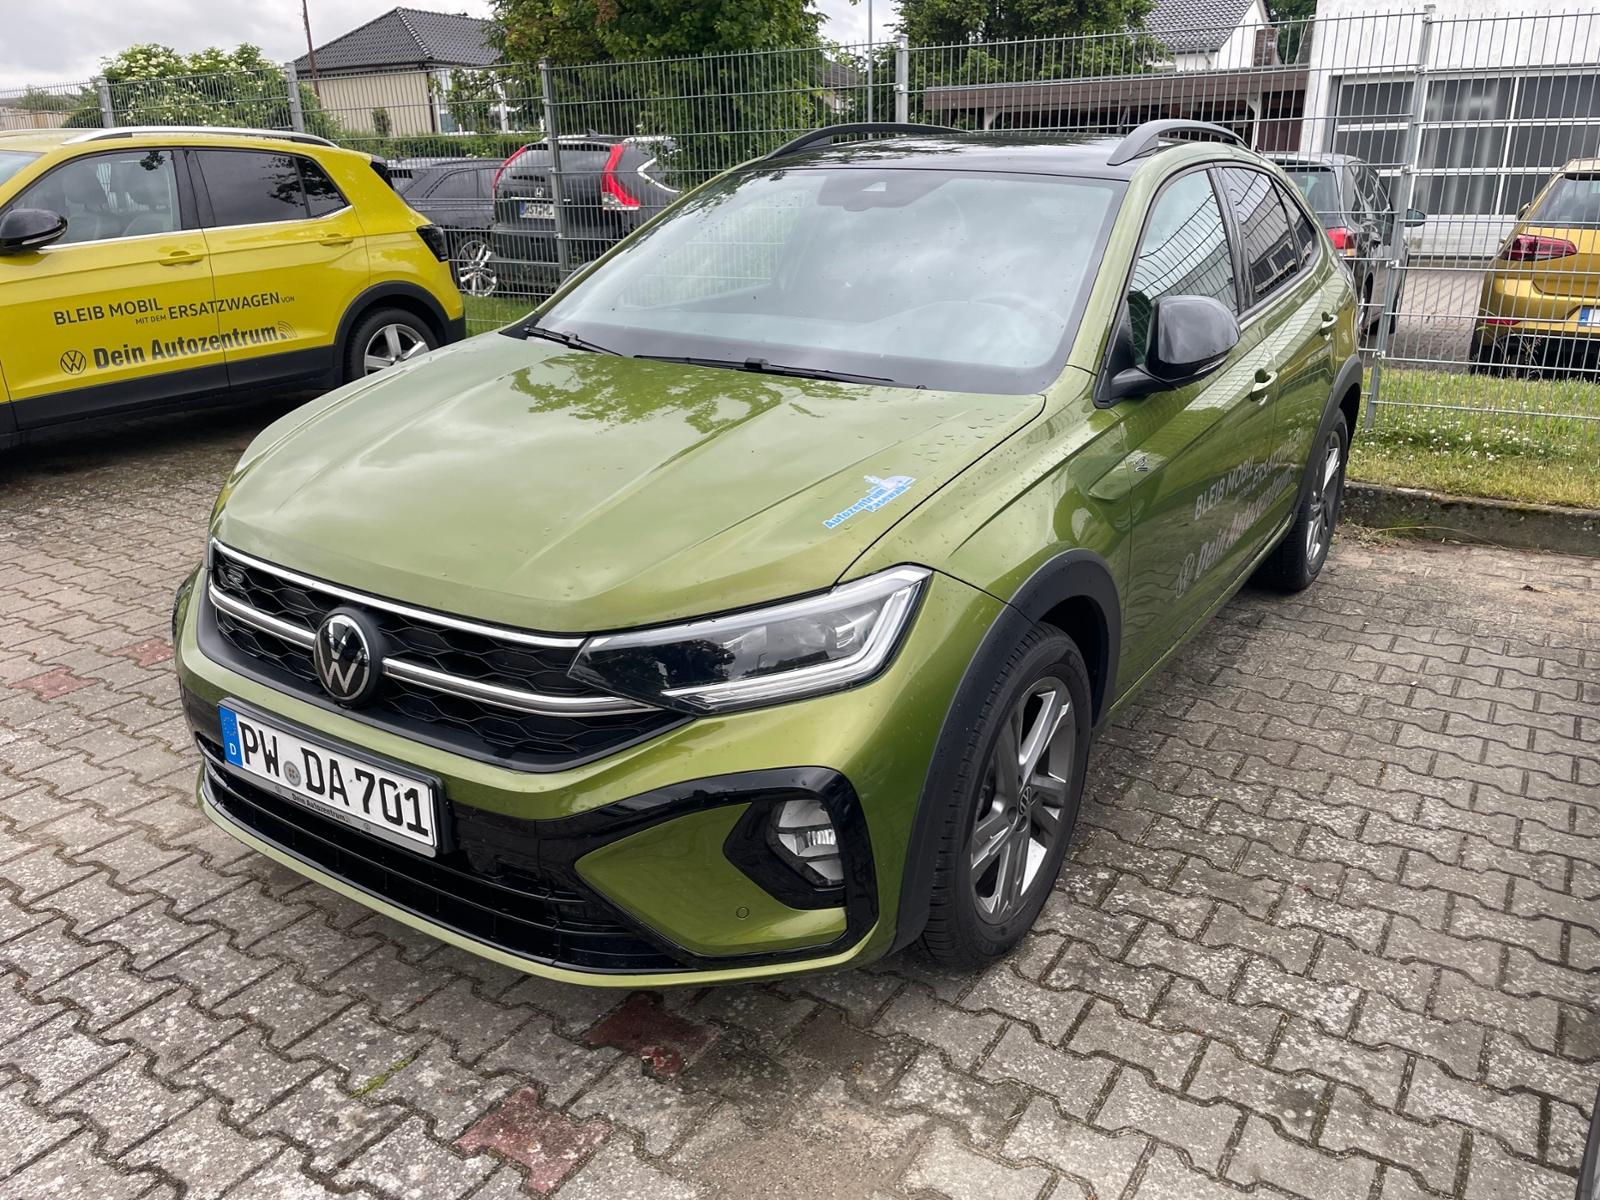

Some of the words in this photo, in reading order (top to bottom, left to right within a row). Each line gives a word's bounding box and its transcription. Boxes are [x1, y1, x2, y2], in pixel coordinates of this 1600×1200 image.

[54, 305, 105, 325] BLEIB
[109, 297, 163, 317] MOBIL
[135, 315, 150, 325] MIT
[150, 314, 167, 324] DEM
[168, 292, 281, 320] ERSATZWAGEN
[281, 295, 296, 304] VON
[93, 344, 146, 370] Dein
[152, 324, 279, 361] Autozentrum
[1194, 477, 1226, 521] BLEIB
[229, 742, 237, 756] D
[238, 720, 280, 777] PW
[301, 746, 350, 806] DA
[354, 767, 430, 837] 701
